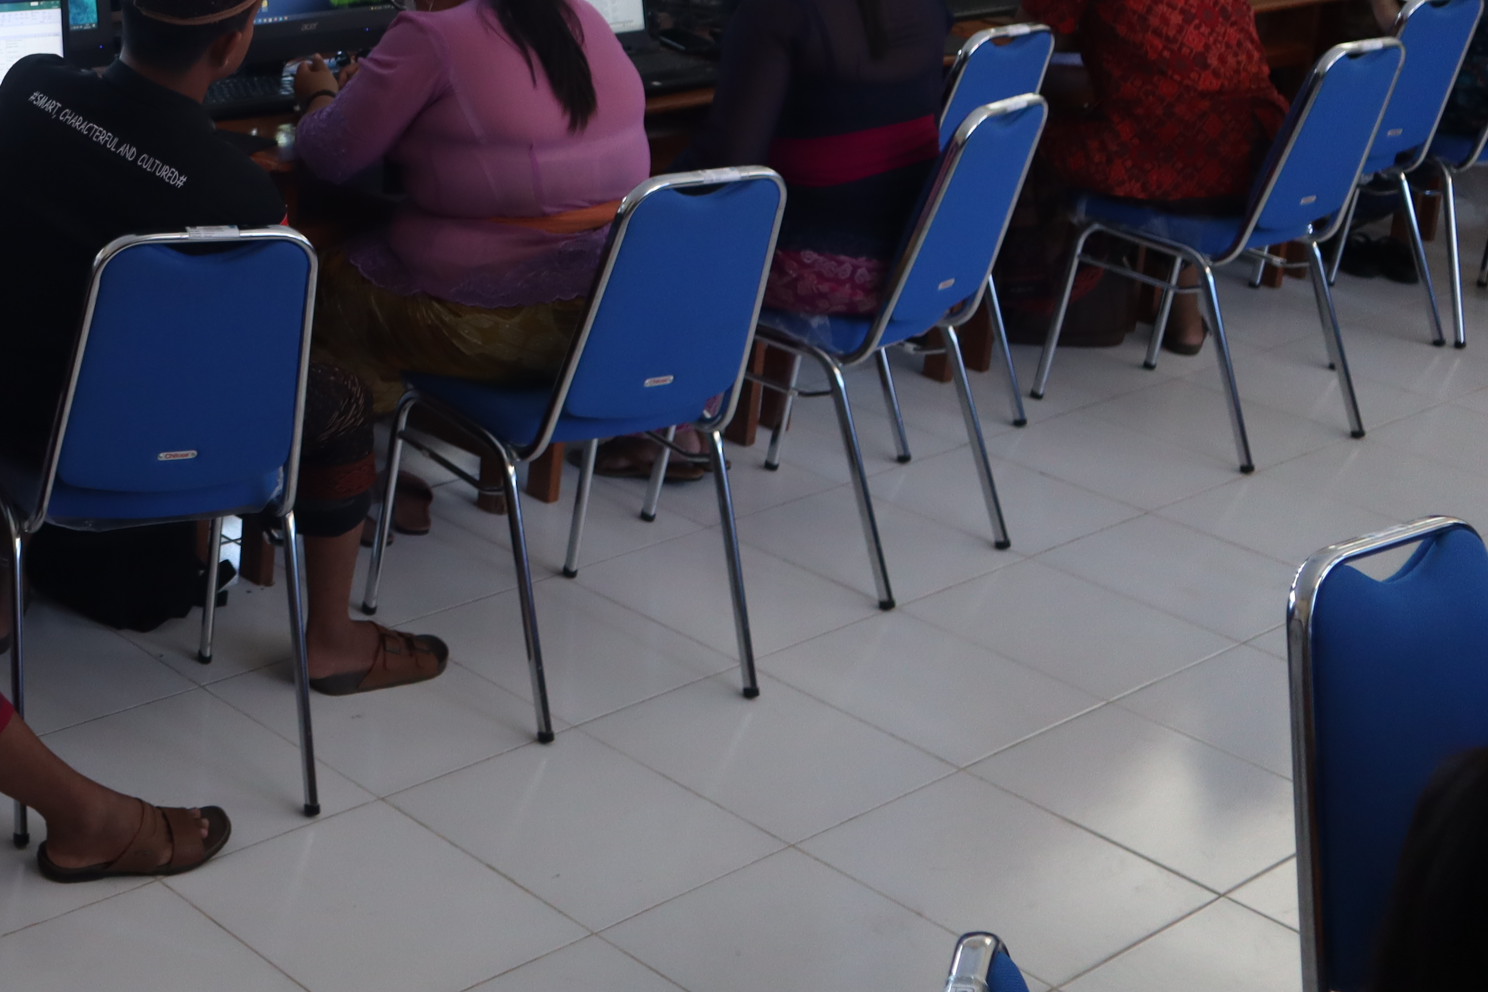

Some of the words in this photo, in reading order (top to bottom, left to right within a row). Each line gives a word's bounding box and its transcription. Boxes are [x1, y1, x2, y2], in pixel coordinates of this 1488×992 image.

[28, 91, 62, 119] #SMART,
[59, 109, 119, 152] CHARACTERFUL
[116, 143, 137, 161] AND
[137, 154, 187, 188] CULTURED#
